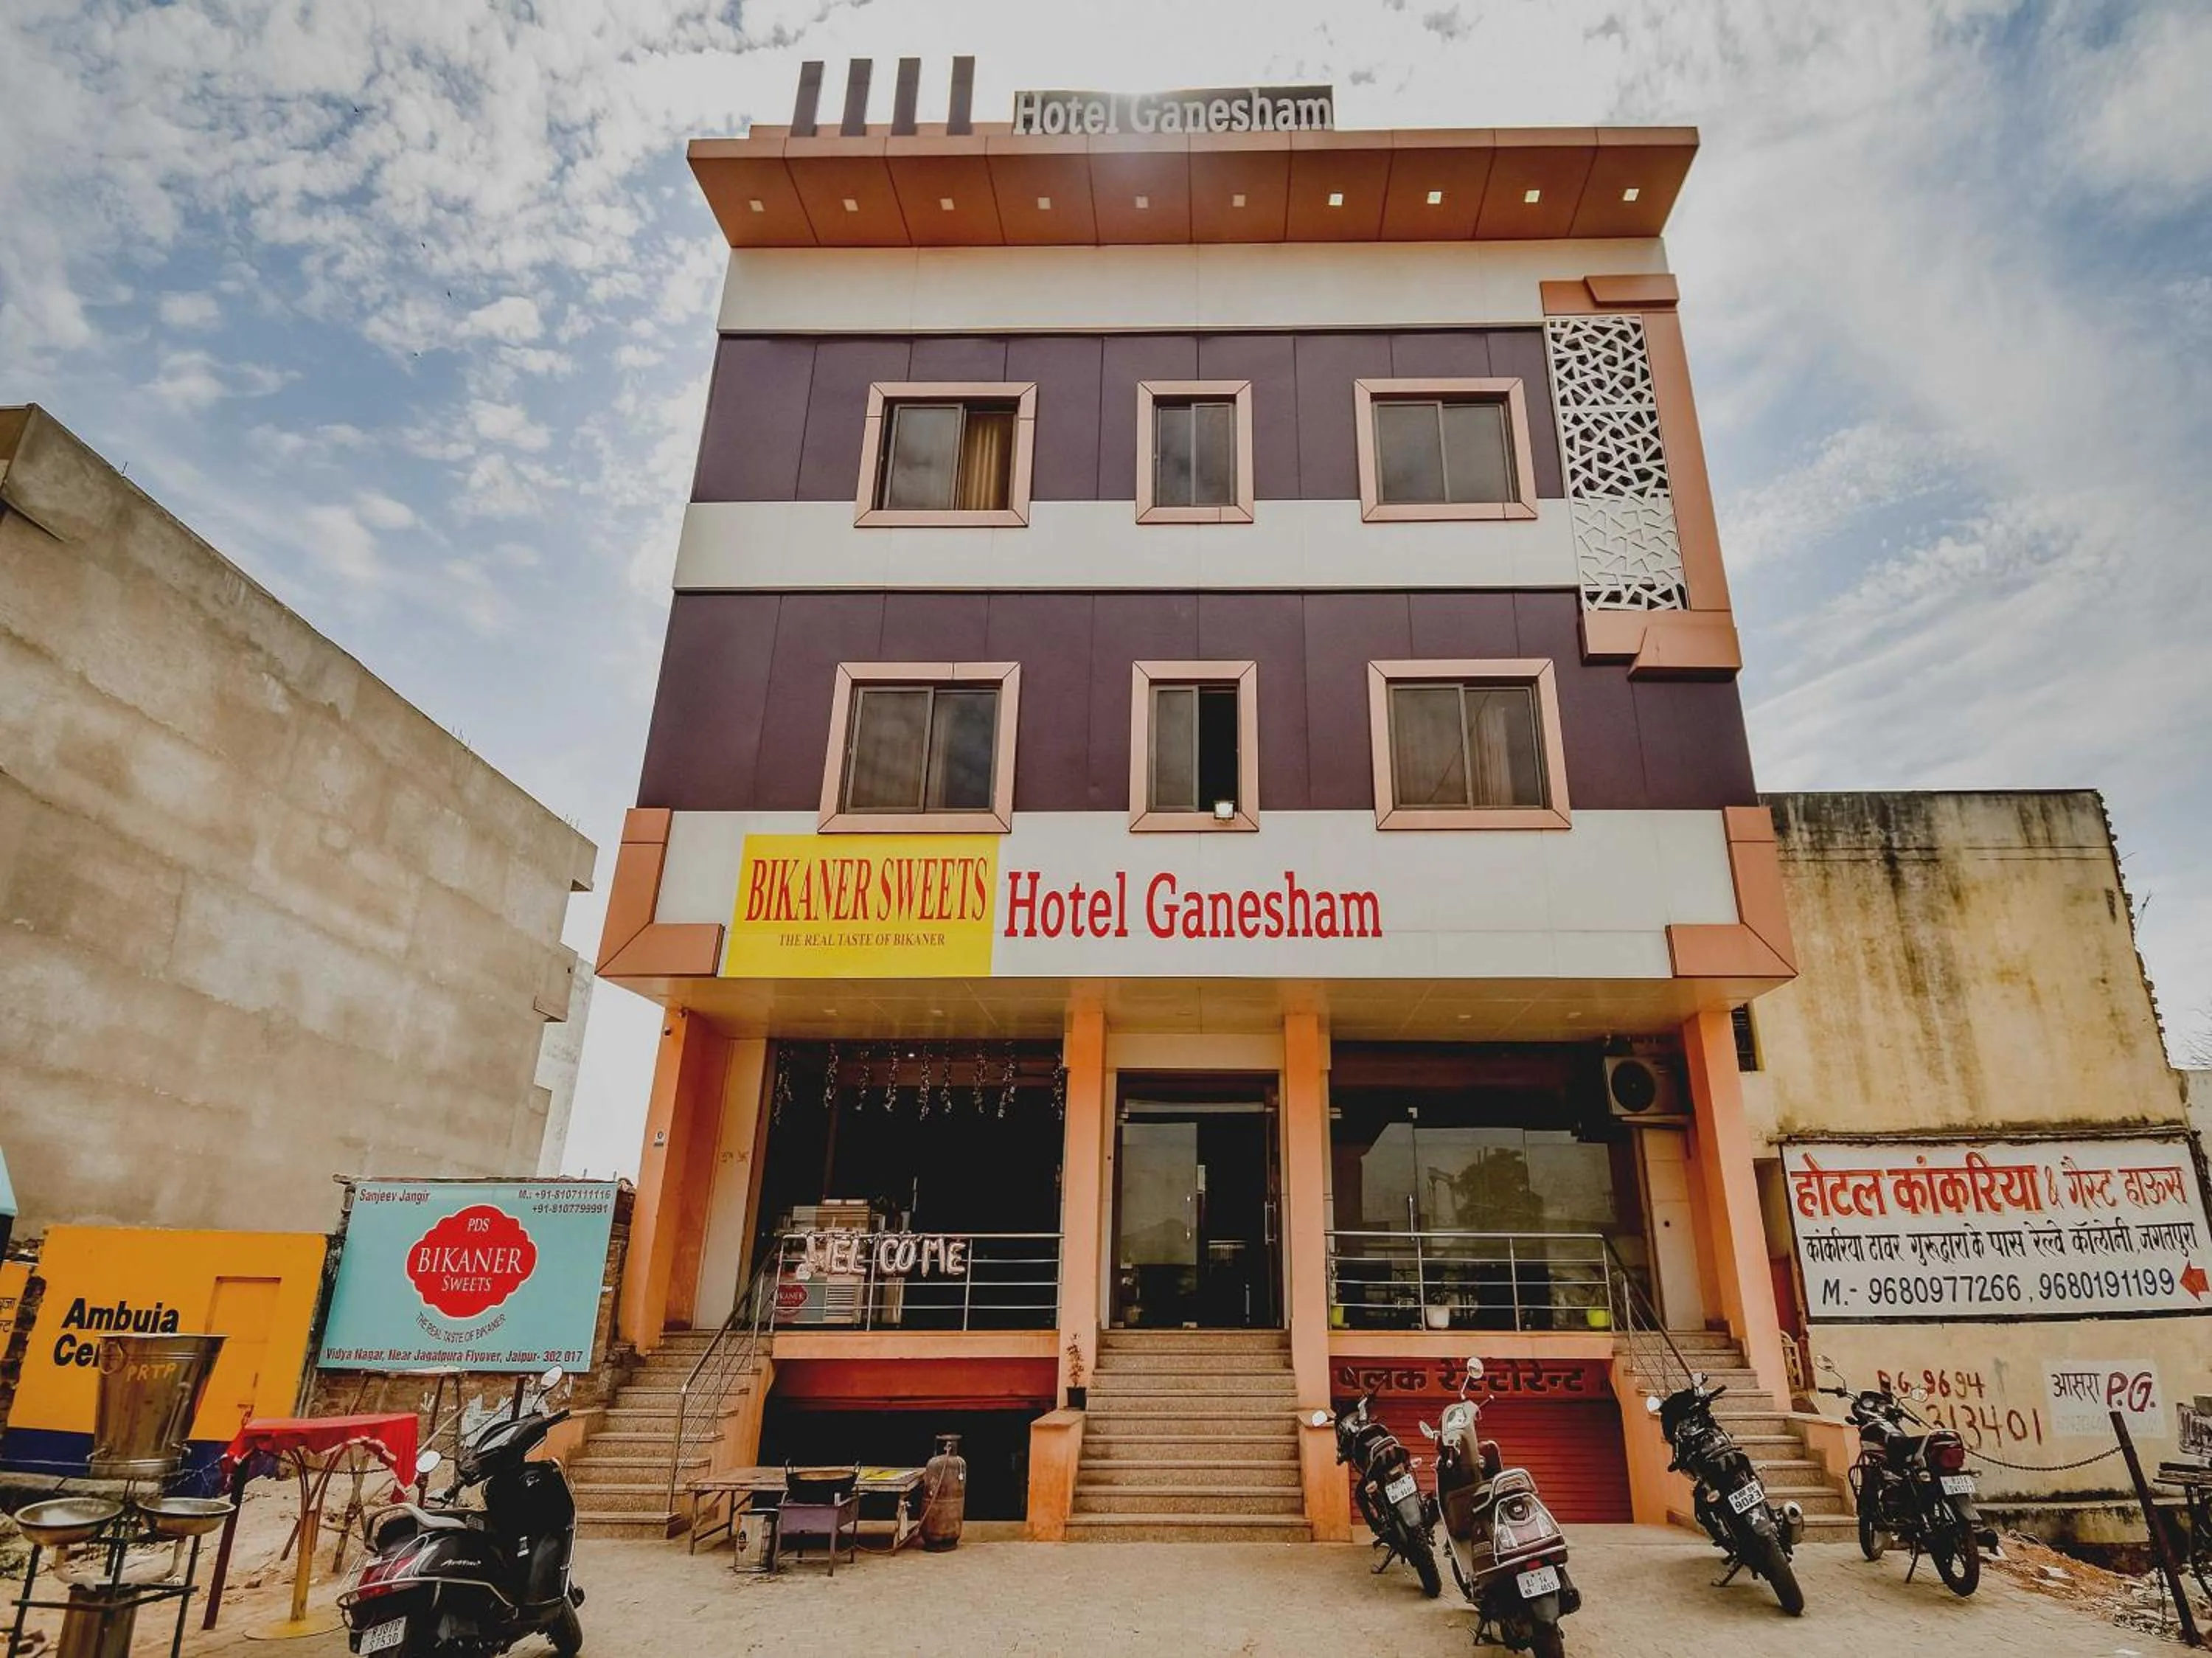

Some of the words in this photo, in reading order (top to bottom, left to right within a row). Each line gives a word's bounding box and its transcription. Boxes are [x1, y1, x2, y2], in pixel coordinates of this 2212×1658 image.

[1013, 91, 1119, 135] Hotel
[1129, 88, 1333, 134] Ganesham
[745, 858, 872, 922] BIKANER
[877, 856, 989, 922] SWEETS
[1004, 870, 1128, 937] Hotel
[1146, 870, 1382, 939] Ganesham
[779, 933, 802, 946] THE
[804, 933, 835, 946] REAL
[838, 933, 874, 946] TASTE
[875, 933, 890, 946] OF
[892, 933, 945, 946] BIKANER
[359, 1188, 397, 1204] Sanjeev
[399, 1188, 431, 1205] Jangir
[1790, 1152, 1887, 1217] होटल
[1886, 1151, 2043, 1215] कांकरिया
[2118, 1166, 2188, 1210] हाऊस
[467, 1218, 490, 1232] PDS
[1803, 1227, 1865, 1263] कांकरिया
[1865, 1234, 1905, 1262] टावर
[1964, 1223, 1984, 1258] के
[1986, 1230, 2027, 1258] पास
[2135, 1221, 2198, 1258] जगतपुरा
[417, 1246, 524, 1274] BIKANER
[442, 1274, 492, 1292] SWEETS
[2039, 1267, 2175, 1301] 9680191199
[326, 1347, 352, 1361] Vidya
[387, 1349, 412, 1361] Near
[563, 1351, 583, 1362] 017
[2051, 1373, 2101, 1404] आसरा
[2106, 1370, 2157, 1412] P.G.
[1735, 1489, 1763, 1511] 9023
